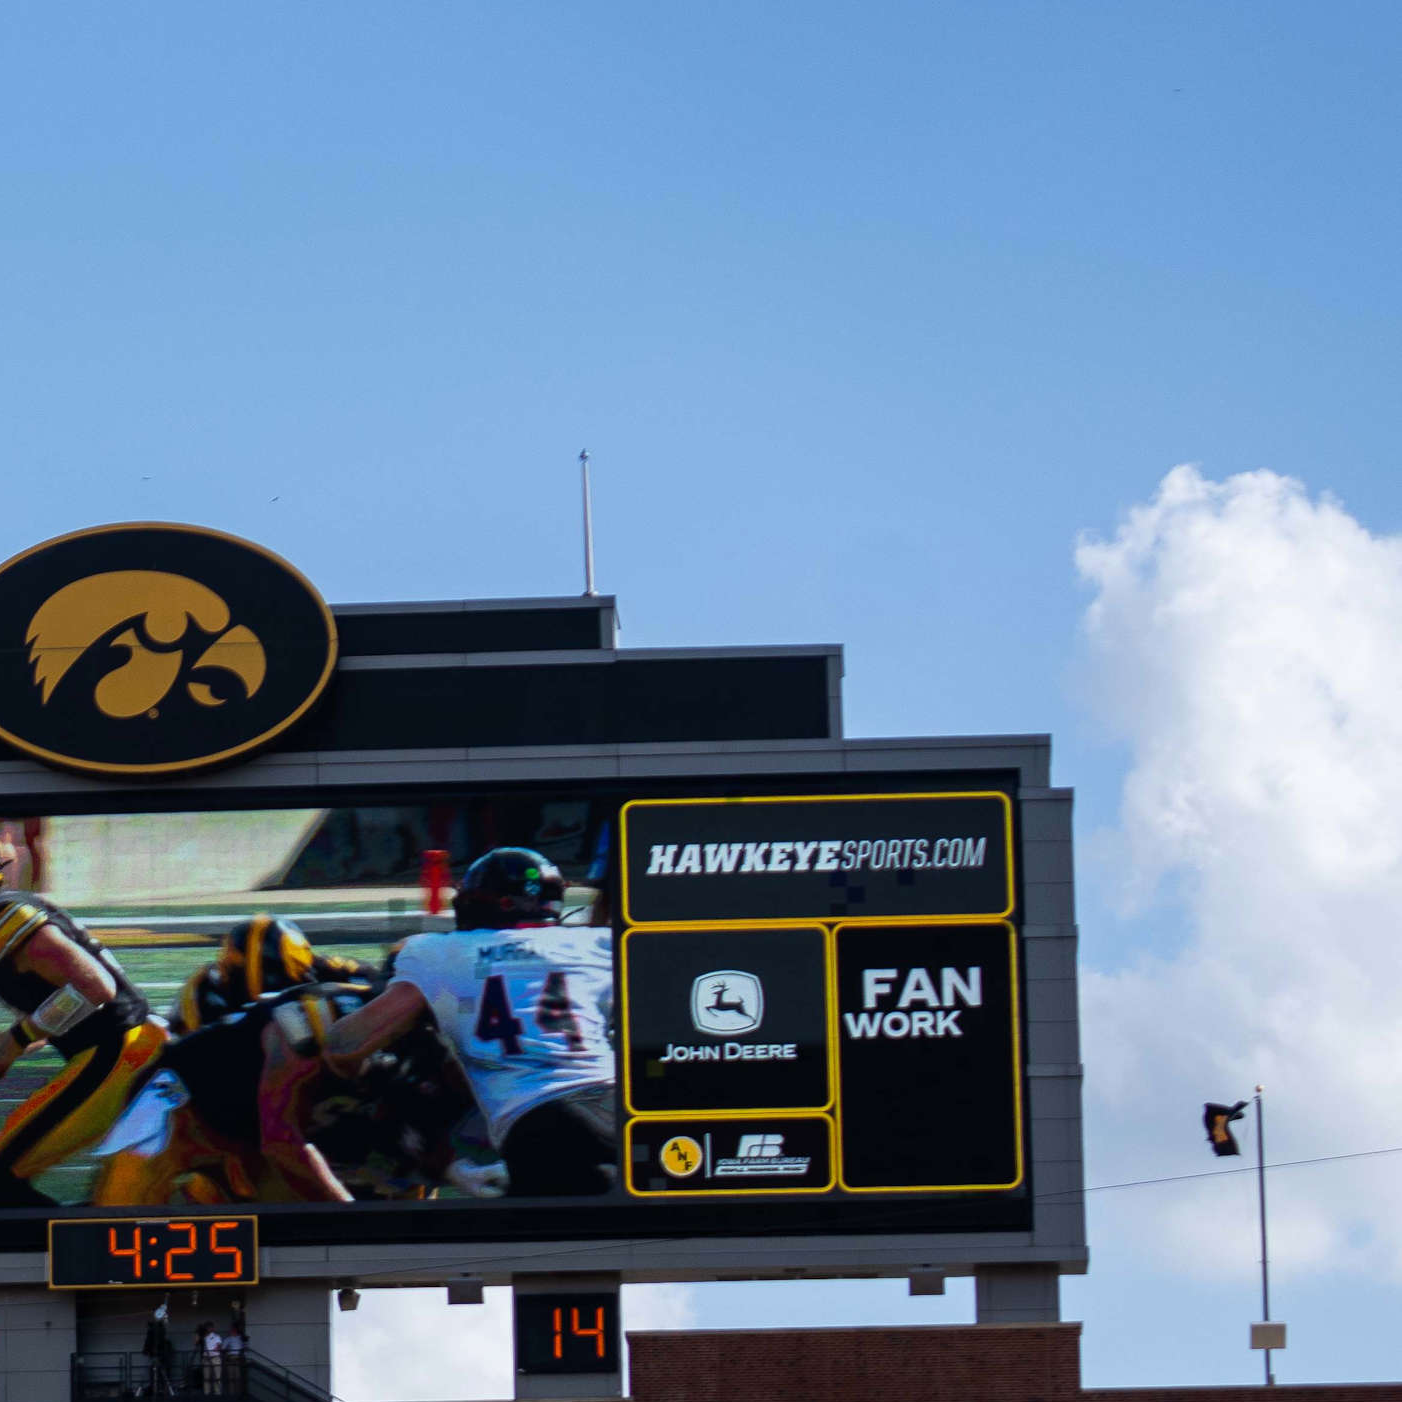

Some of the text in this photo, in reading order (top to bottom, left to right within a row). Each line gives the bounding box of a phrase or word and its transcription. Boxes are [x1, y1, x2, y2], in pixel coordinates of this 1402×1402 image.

[645, 837, 986, 876] HAWKEYESPORTS.COM
[862, 966, 982, 1009] FAN
[844, 1009, 963, 1040] WORK
[108, 1221, 243, 1280] 4:25
[552, 1305, 606, 1359] 14
